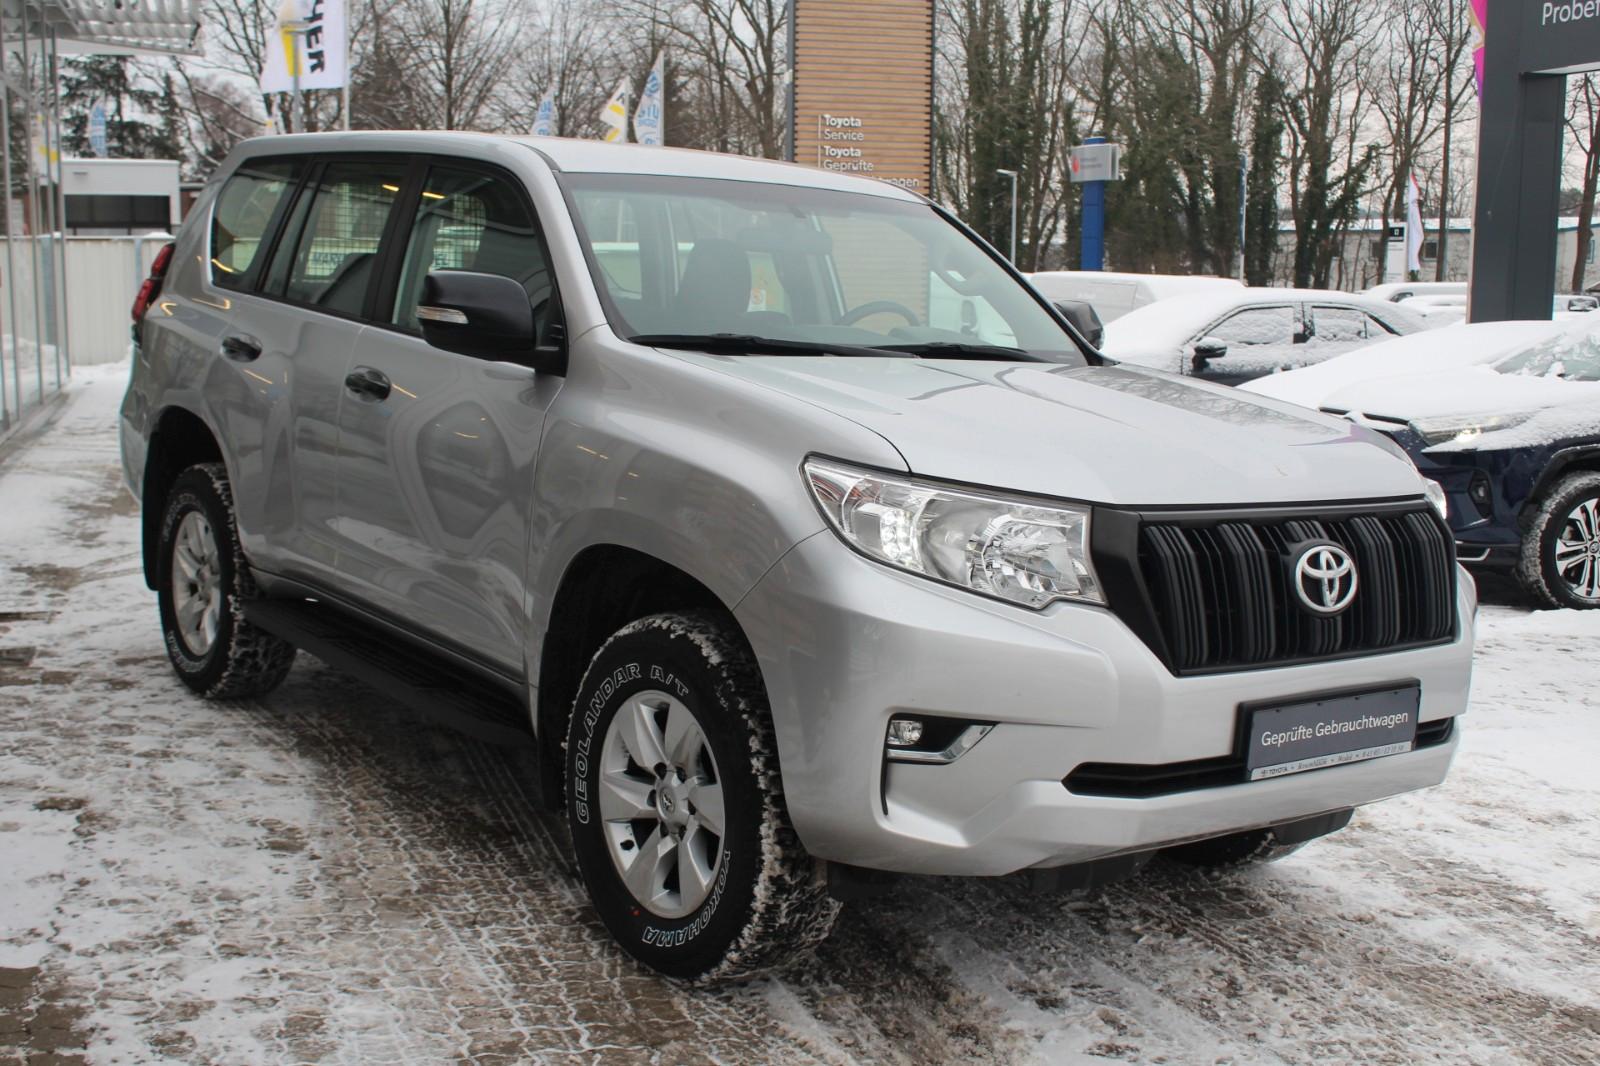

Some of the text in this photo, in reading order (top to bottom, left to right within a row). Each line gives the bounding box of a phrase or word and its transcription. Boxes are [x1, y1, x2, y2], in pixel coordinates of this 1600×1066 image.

[823, 114, 862, 128] Toyota
[823, 129, 864, 141] Service
[823, 145, 862, 158] Toyota
[823, 159, 874, 171] Geprüfte
[1261, 711, 1408, 748] Geprüfte Gebrauchtwagen
[574, 662, 689, 824] GEOLANDAR A/T
[641, 849, 732, 948] YOKOHAMA
